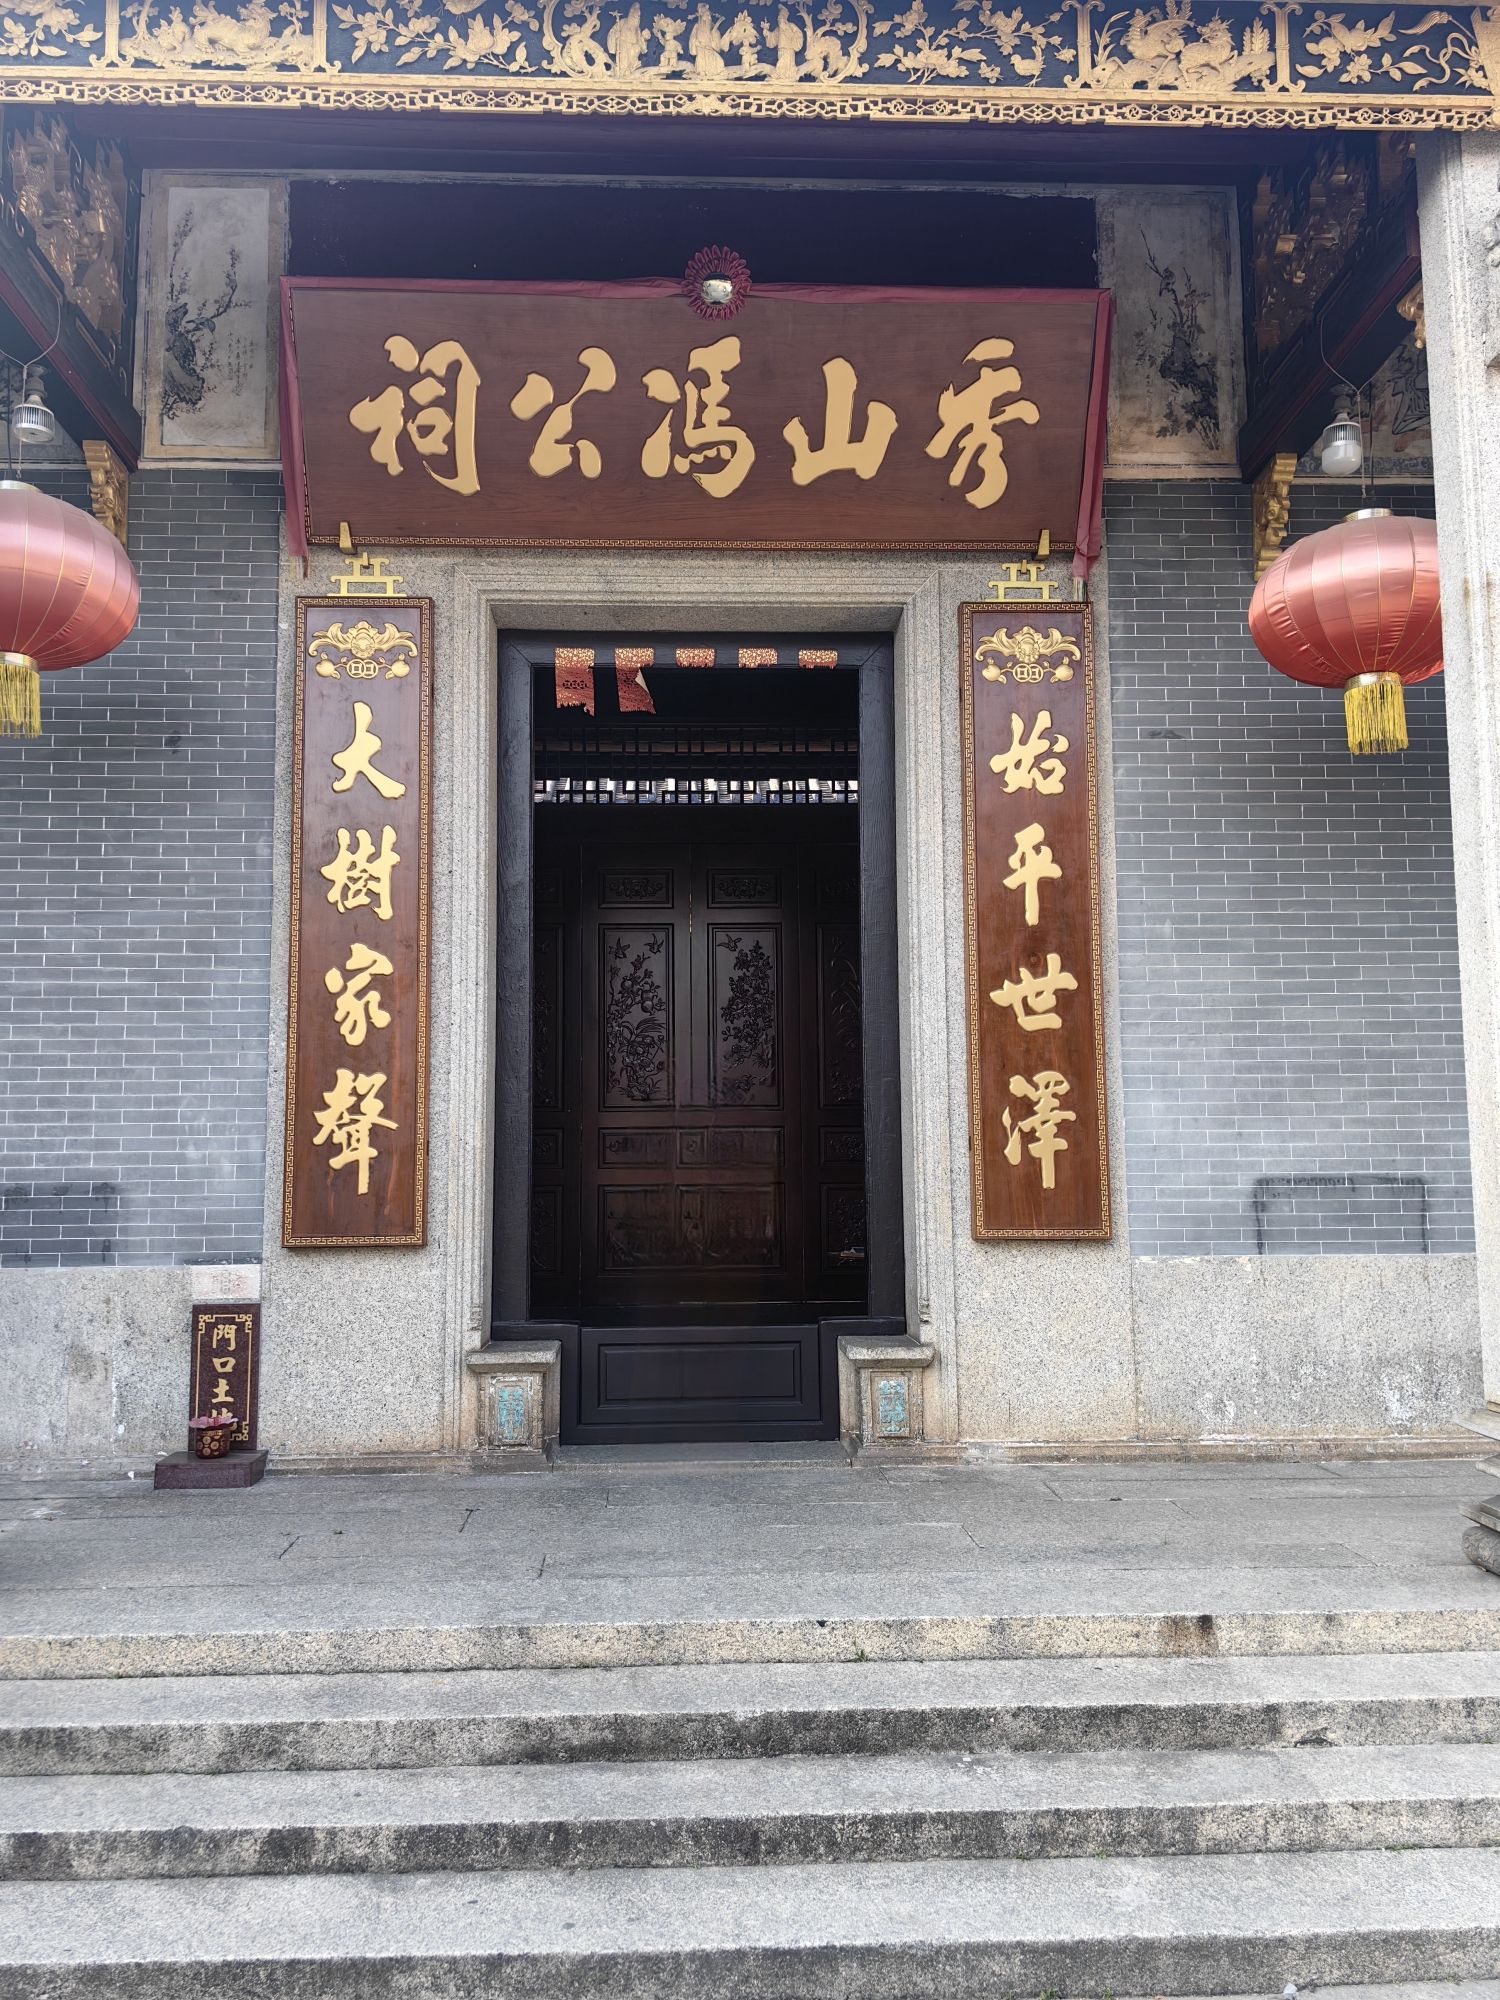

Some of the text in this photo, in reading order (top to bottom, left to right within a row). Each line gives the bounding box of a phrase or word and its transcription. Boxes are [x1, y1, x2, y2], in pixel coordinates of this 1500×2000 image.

[312, 701, 406, 1196] 大樹家聲
[990, 710, 1078, 1189] 始平世澤
